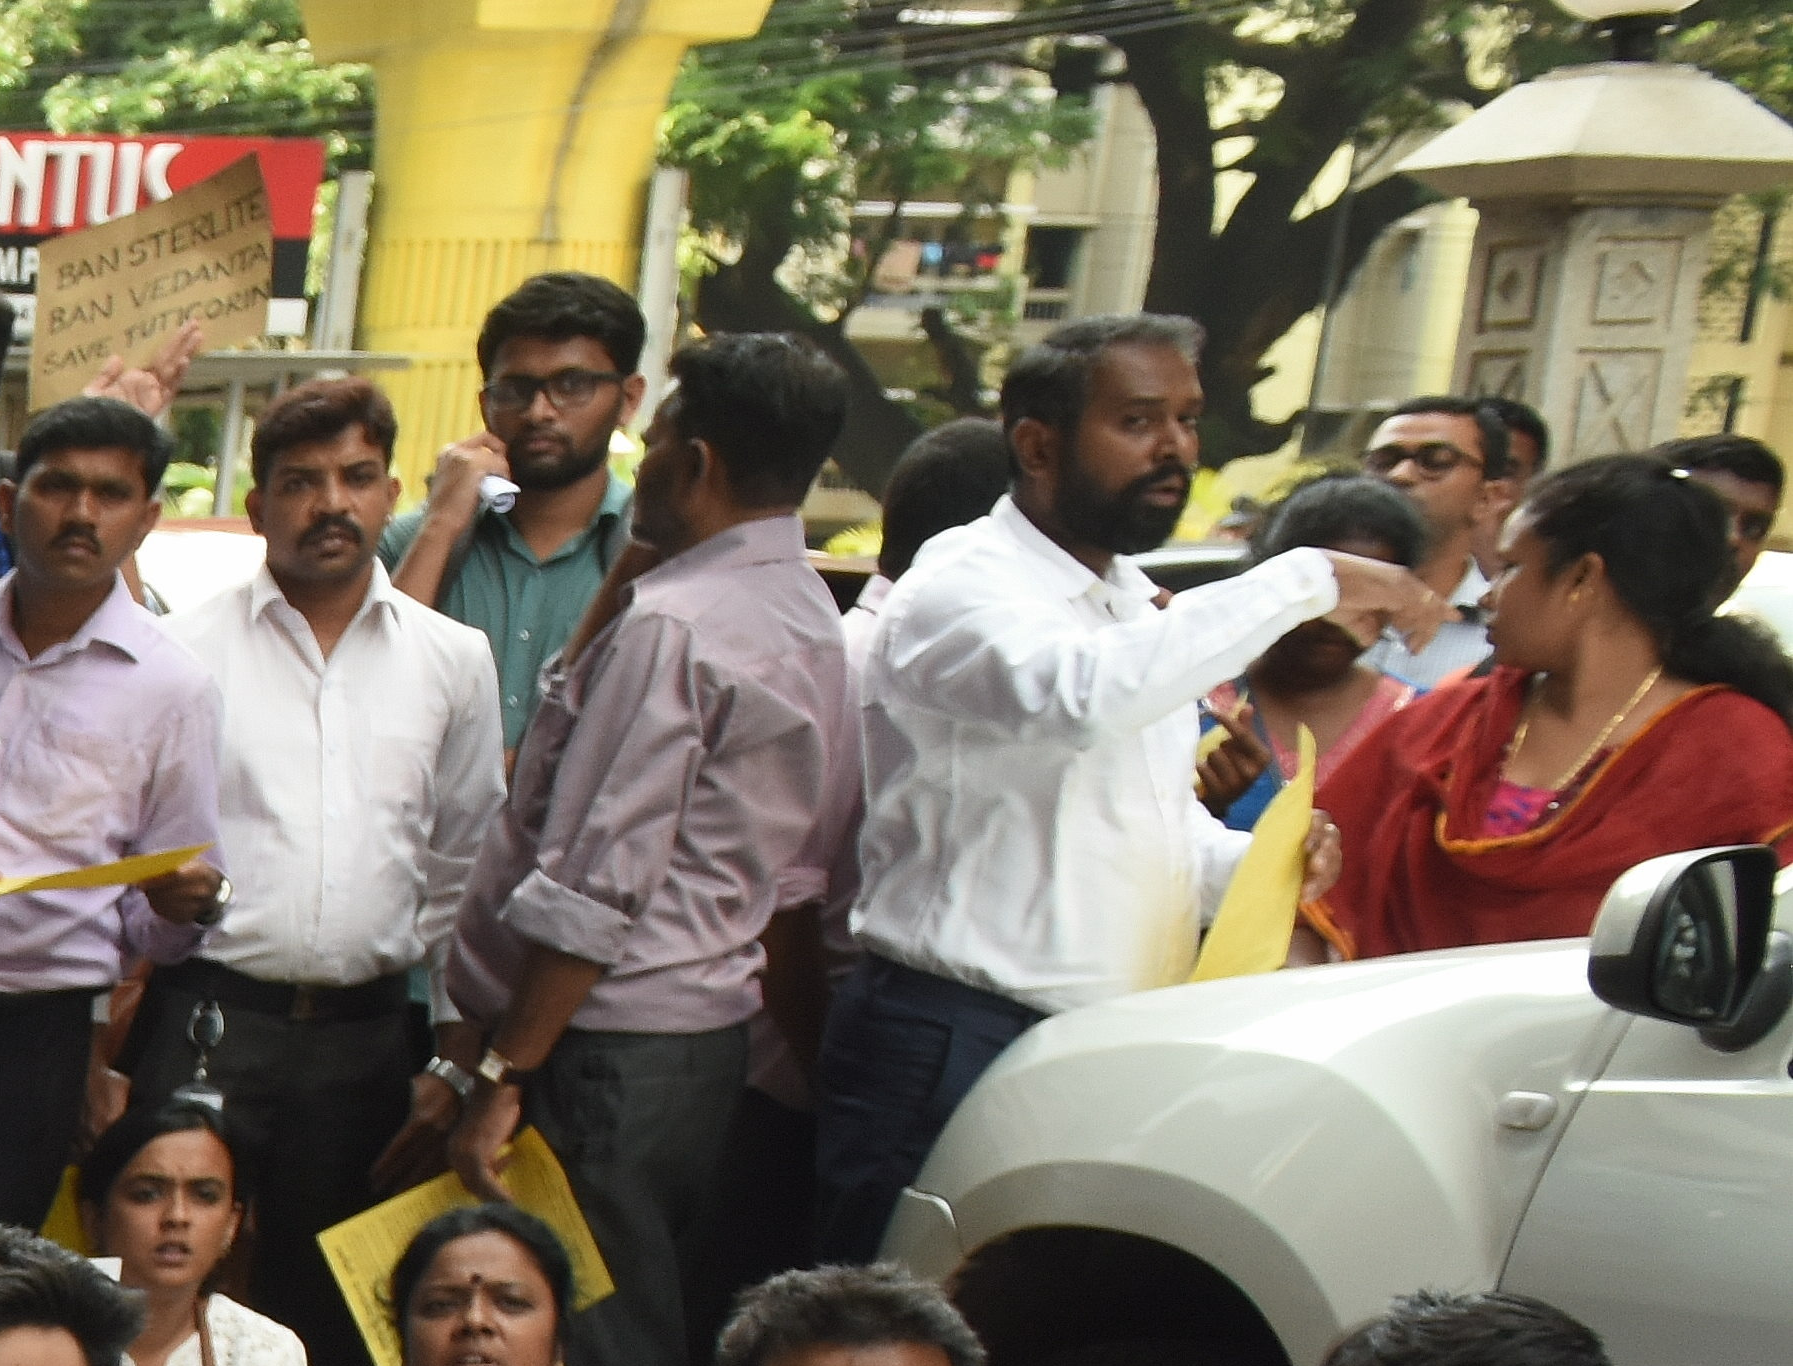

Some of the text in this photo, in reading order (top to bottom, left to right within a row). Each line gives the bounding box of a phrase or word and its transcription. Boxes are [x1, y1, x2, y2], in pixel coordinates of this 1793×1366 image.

[56, 187, 267, 291] BAN STERLITE
[43, 281, 269, 376] SAVE TUTICORIN
[49, 242, 270, 337] BAN VEDANTA
